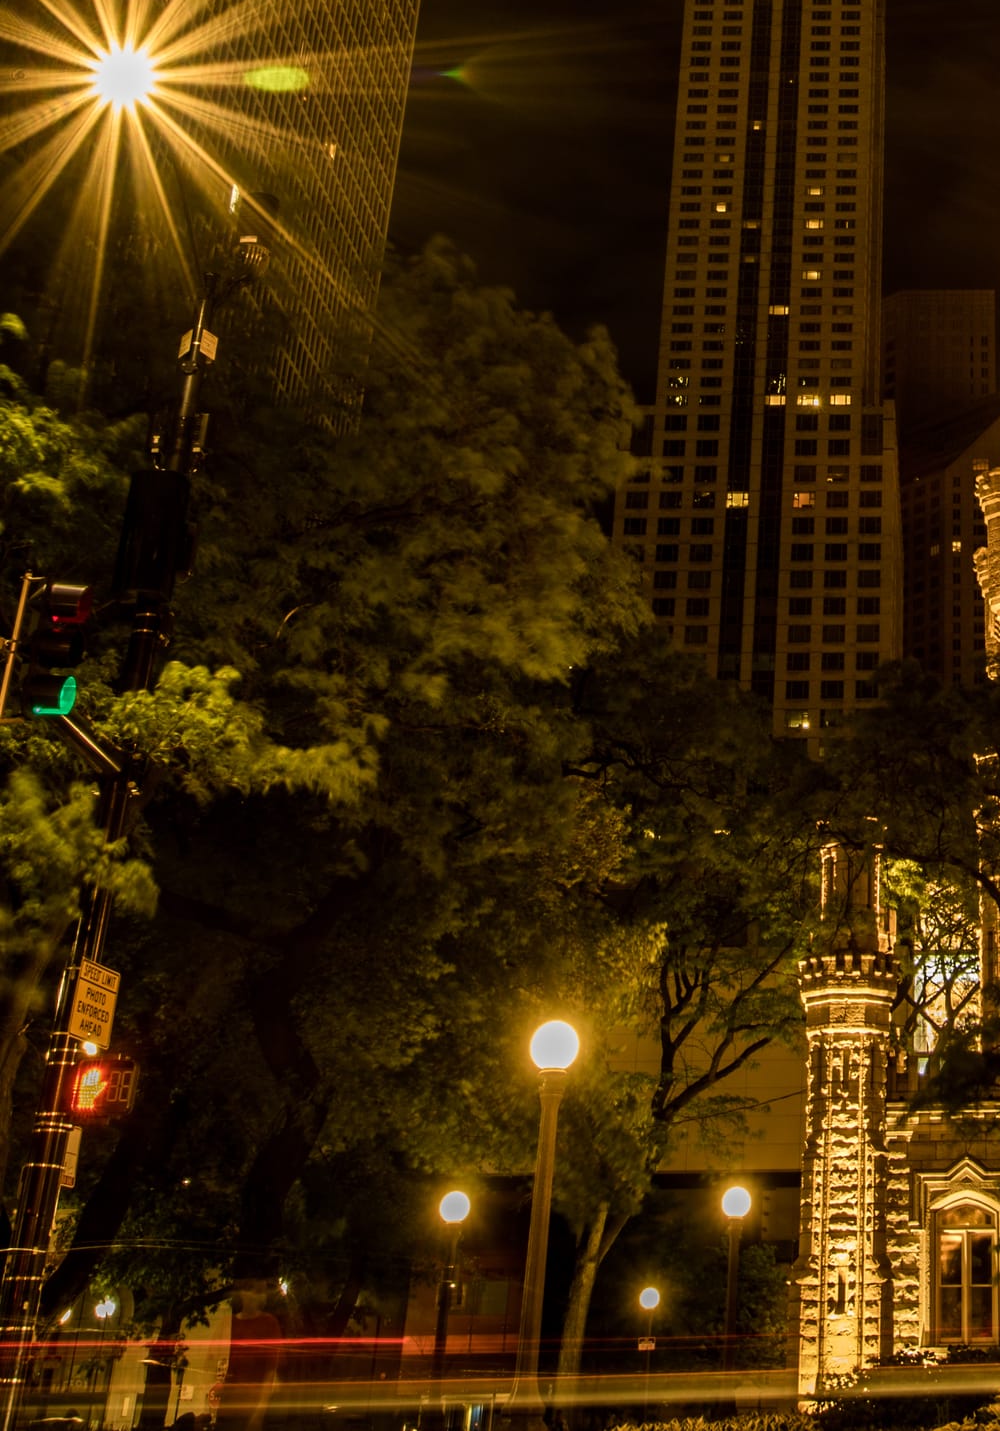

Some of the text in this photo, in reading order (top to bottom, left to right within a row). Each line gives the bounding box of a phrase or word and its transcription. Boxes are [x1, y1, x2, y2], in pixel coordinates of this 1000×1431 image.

[84, 964, 117, 988] SPEED LIMIT
[86, 987, 106, 1006] PHOTO
[77, 1000, 110, 1024] ENFORCED
[80, 1018, 102, 1037] AHEAD
